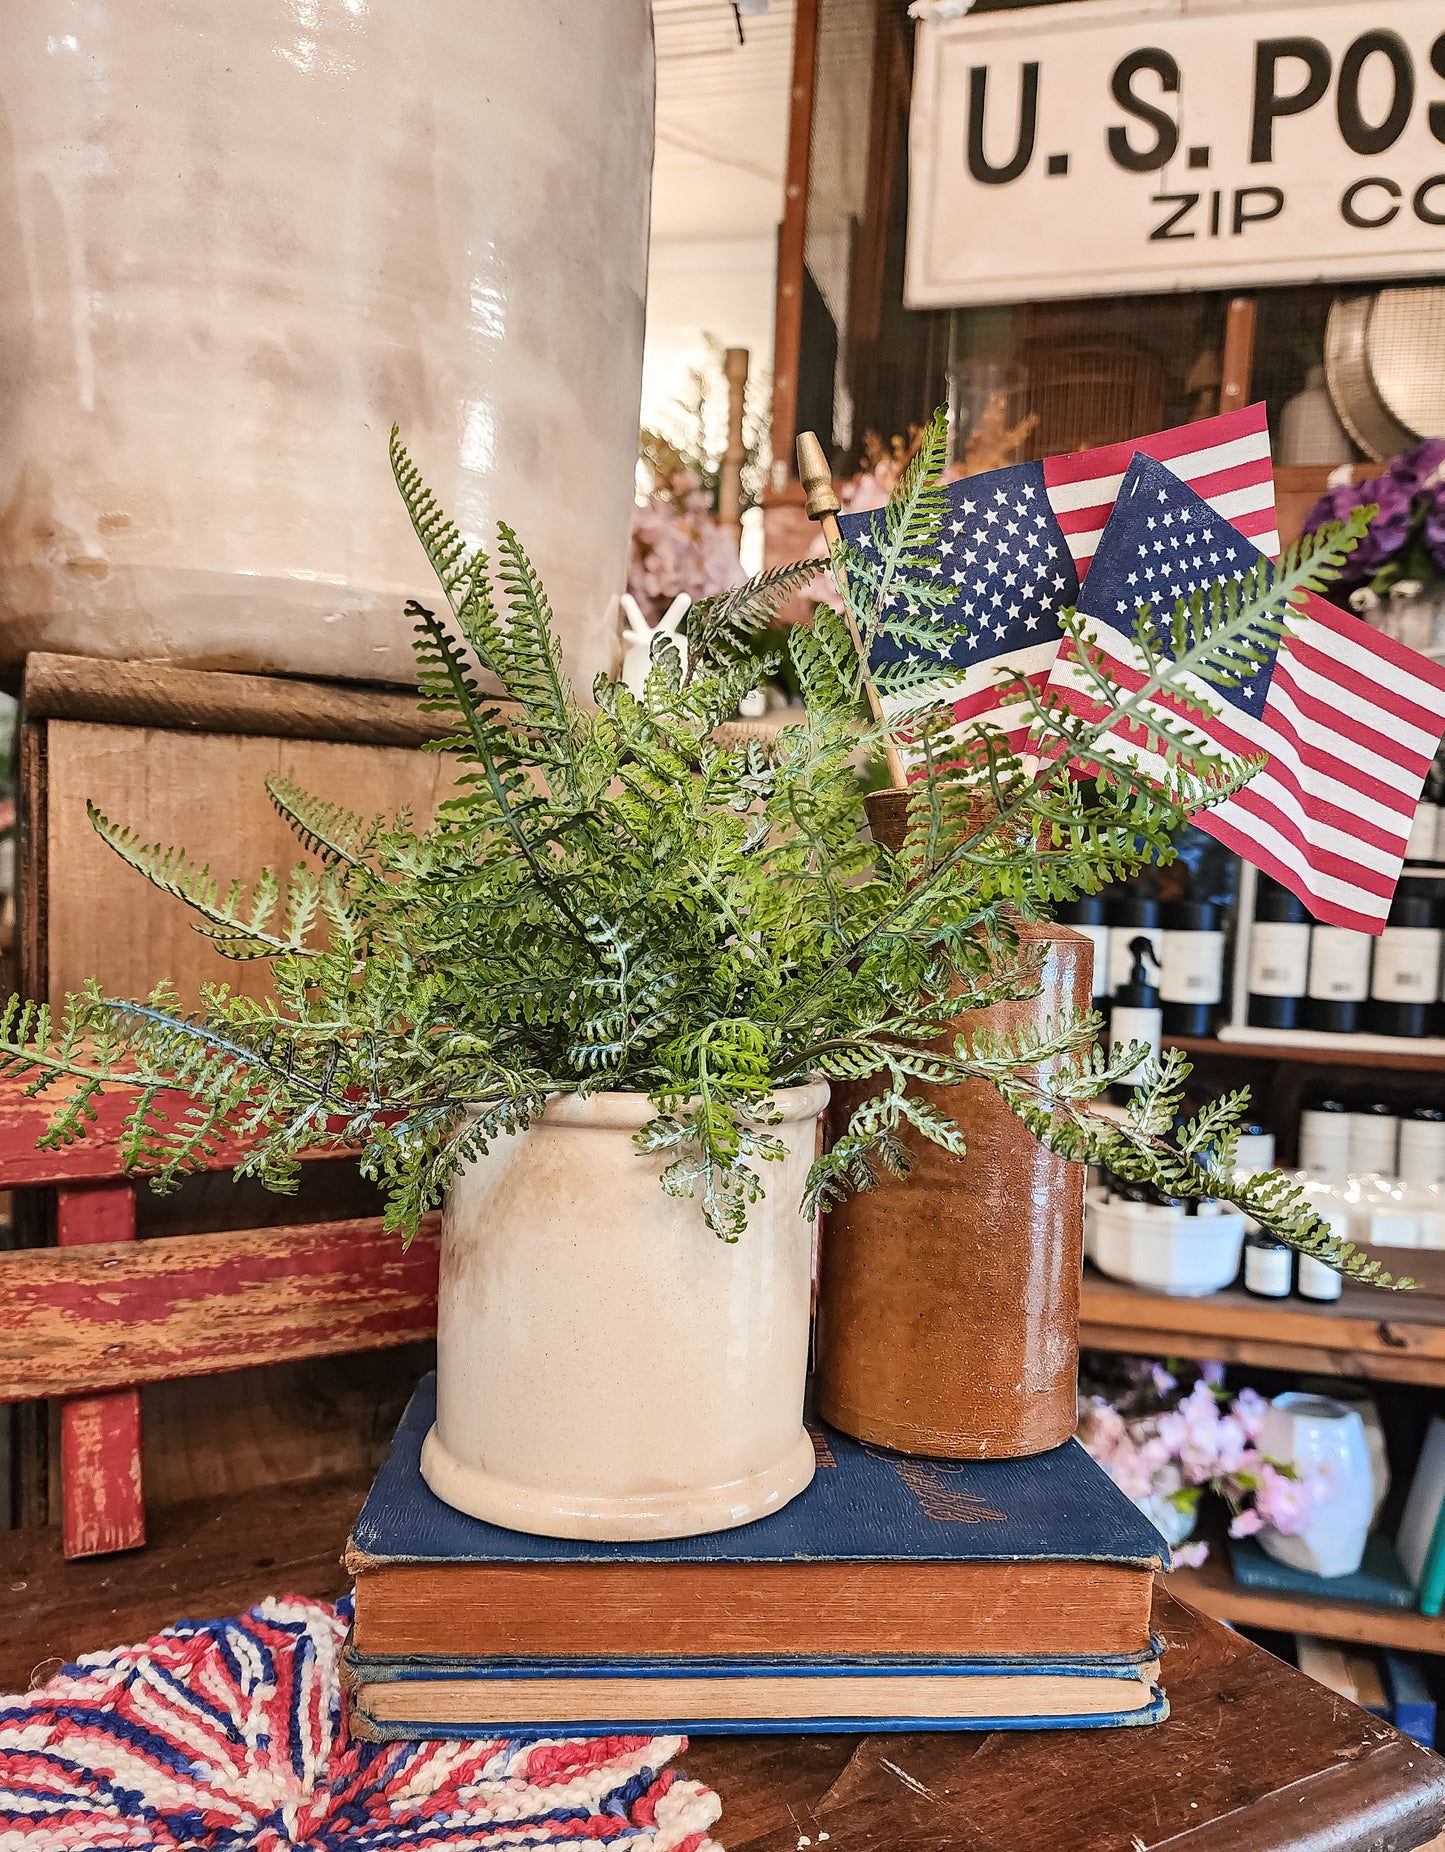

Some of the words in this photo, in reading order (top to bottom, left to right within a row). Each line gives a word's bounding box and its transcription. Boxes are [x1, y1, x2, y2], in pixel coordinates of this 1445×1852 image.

[967, 61, 1069, 186] U.
[1107, 47, 1210, 174] S.
[1249, 29, 1445, 164] PO
[1149, 186, 1285, 241] ZIP
